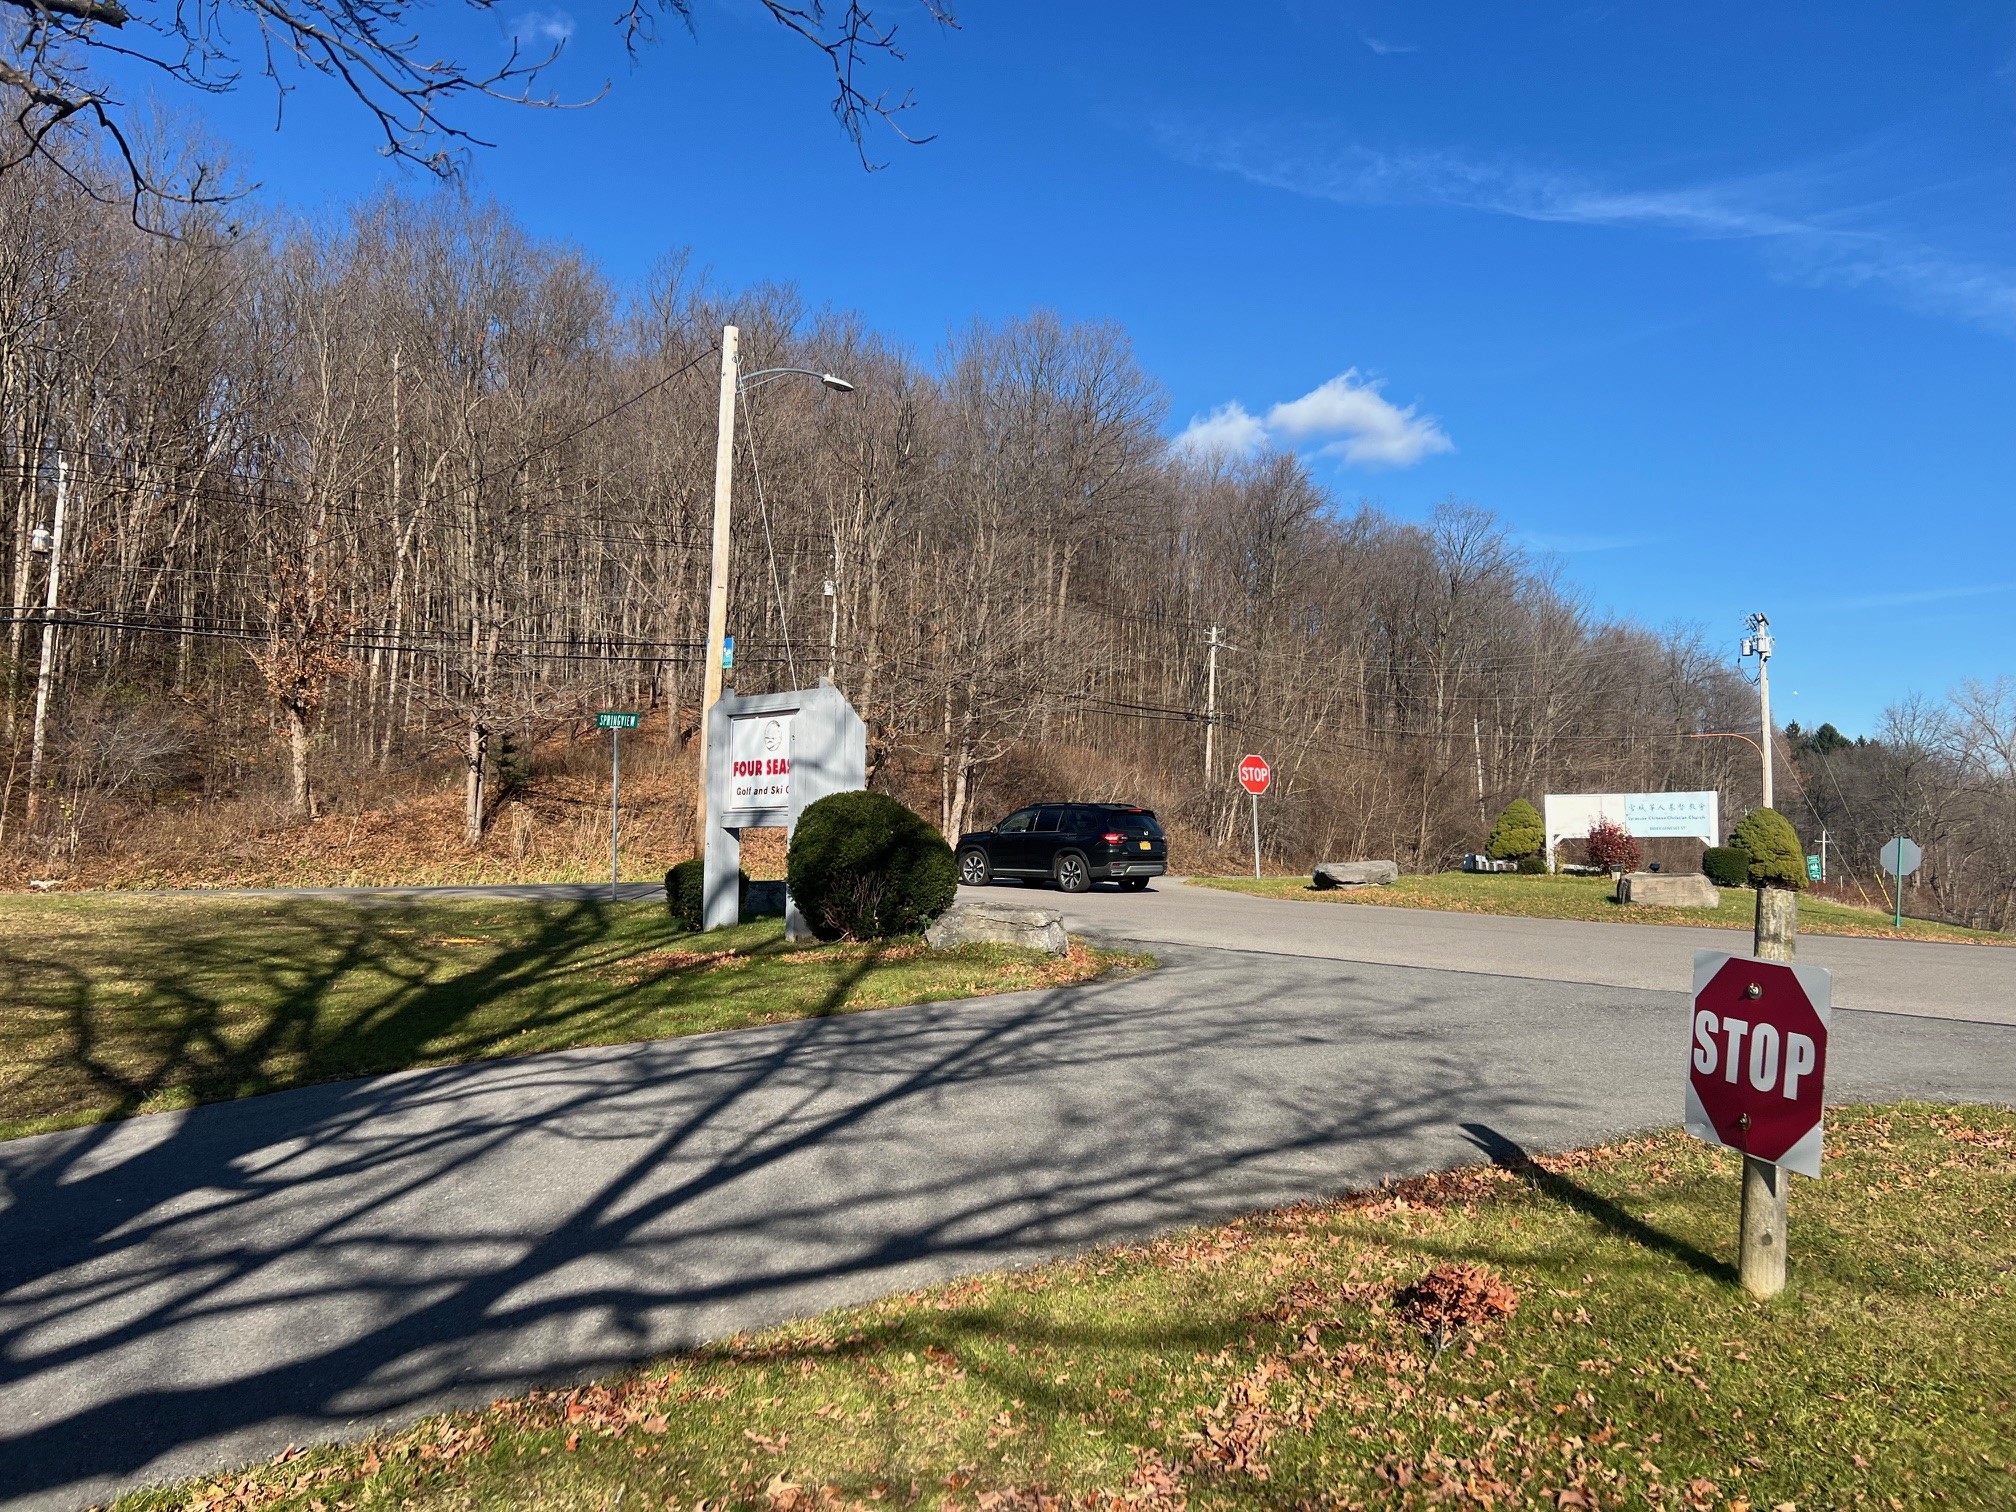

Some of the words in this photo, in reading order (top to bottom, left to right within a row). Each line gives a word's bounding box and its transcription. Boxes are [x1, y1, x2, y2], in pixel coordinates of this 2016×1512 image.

[599, 714, 636, 727] SPRINGVIEW
[733, 760, 763, 777] FOUR
[1241, 766, 1268, 782] STOP
[736, 786, 751, 796] Golf
[753, 786, 769, 796] and
[770, 785, 783, 795] Ski
[1693, 1009, 1816, 1101] STOP
